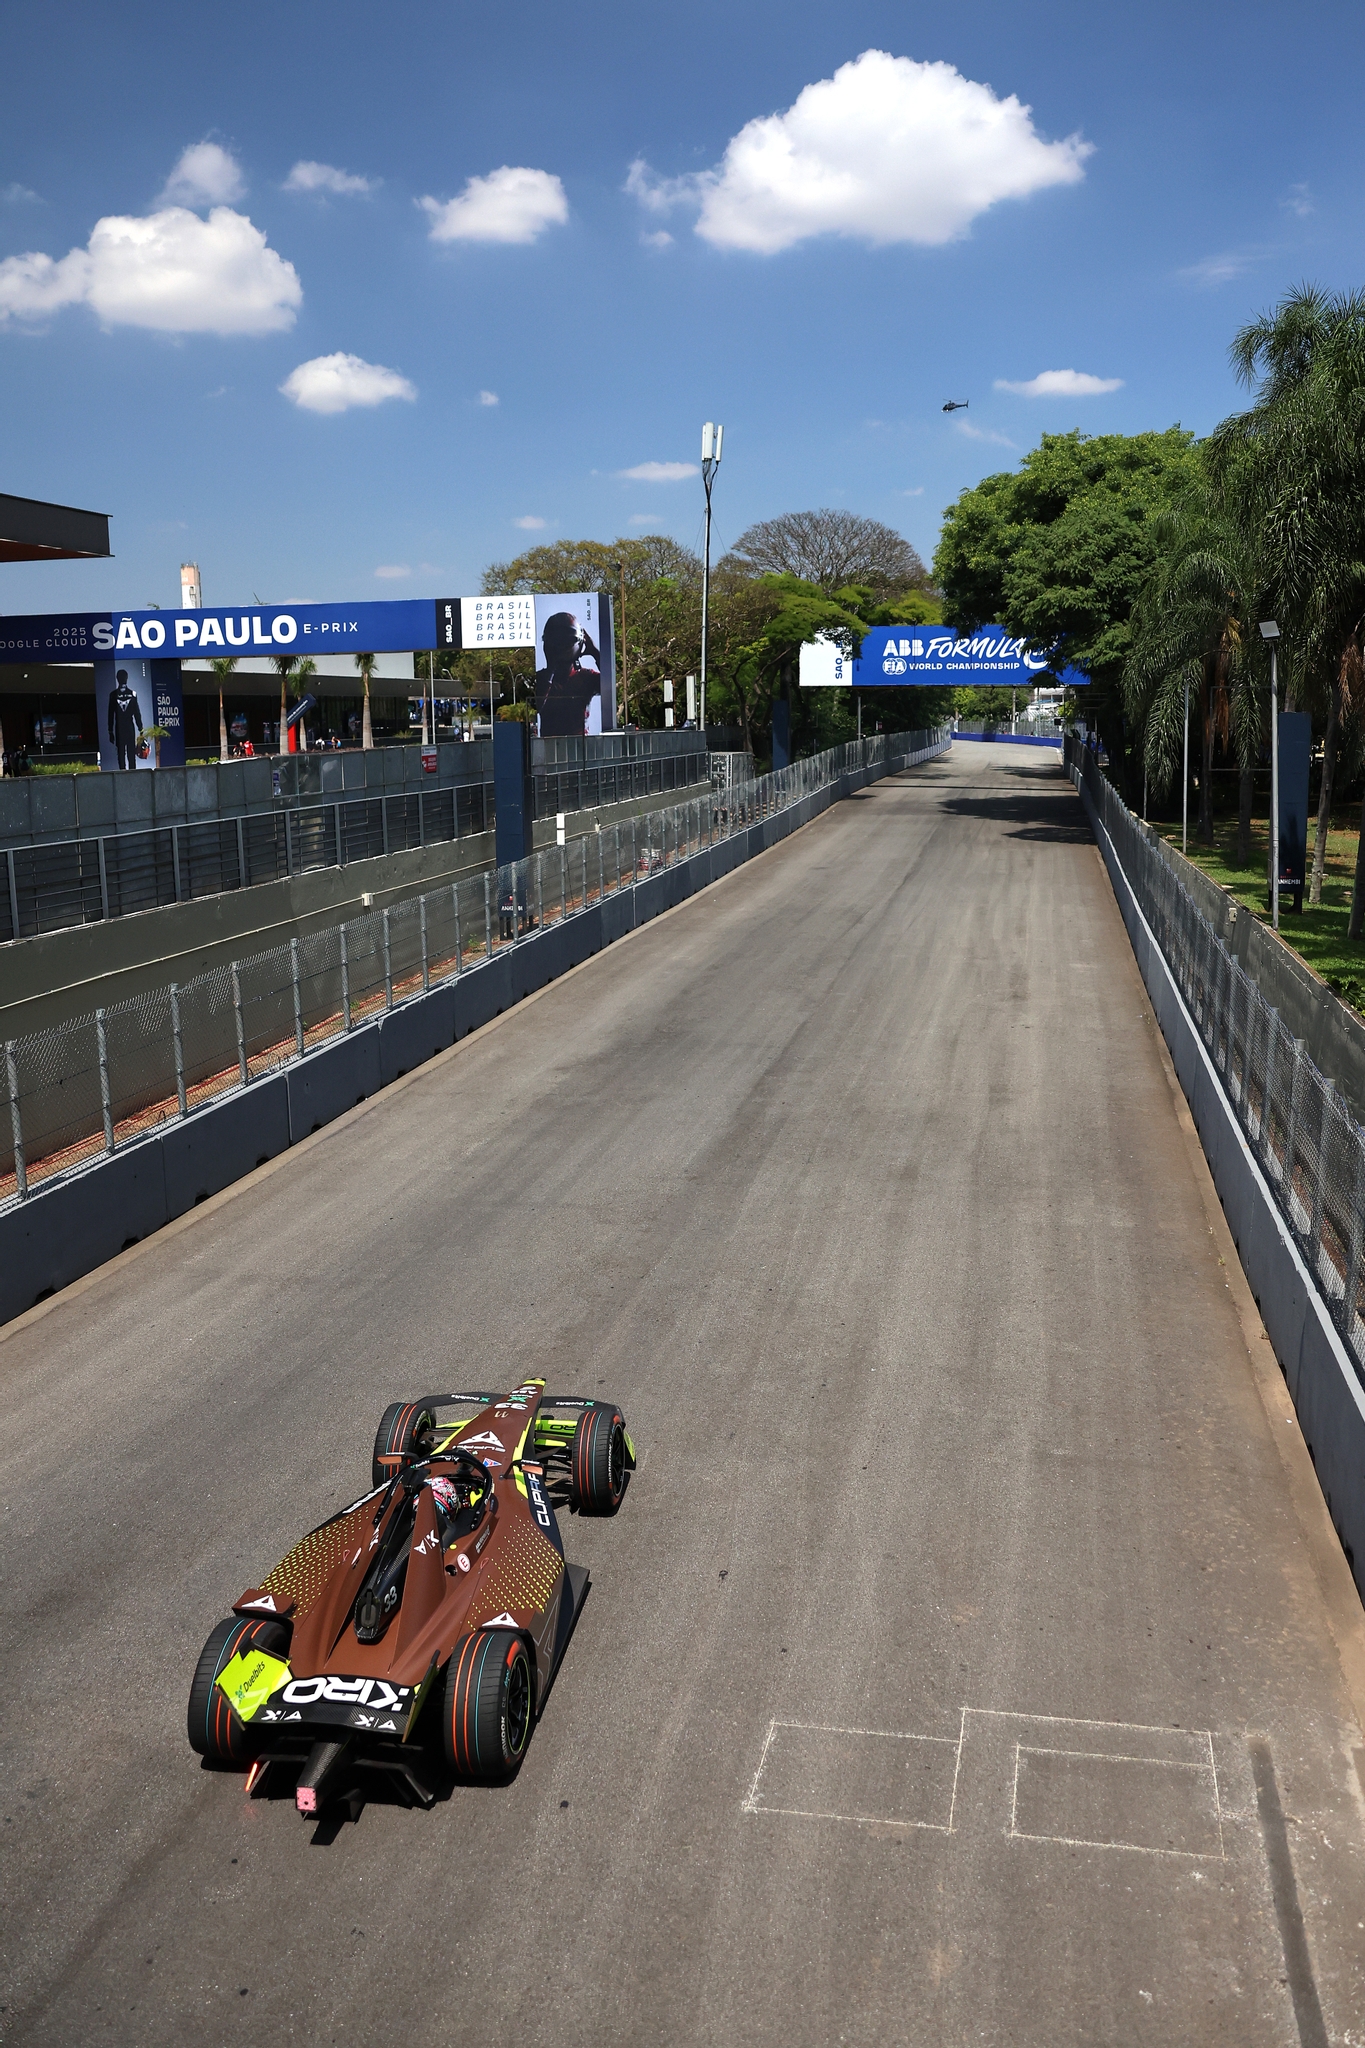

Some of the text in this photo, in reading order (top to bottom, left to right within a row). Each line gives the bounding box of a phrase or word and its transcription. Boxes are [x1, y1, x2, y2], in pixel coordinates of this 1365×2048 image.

[475, 602, 531, 611] BRASIL
[475, 612, 531, 621] BRASIL
[444, 604, 453, 643] SAO_BR
[476, 622, 531, 631] BRASIL
[53, 627, 86, 637] 2025
[92, 614, 358, 650] SÃO PAULO E-PRIX
[476, 632, 532, 641] BRASIL
[0, 637, 87, 649] OOGLE CLOUD
[883, 639, 924, 657] ABB
[925, 636, 1027, 660] FORMULA
[909, 662, 1020, 670] WORLD CHAMPIONSHIP
[157, 693, 171, 706] SÃO
[157, 706, 179, 716] PAULO
[494, 1402, 528, 1410] 33
[384, 1585, 398, 1613] 33
[243, 1660, 266, 1693] Duelbits
[282, 1676, 410, 1711] KIRO
